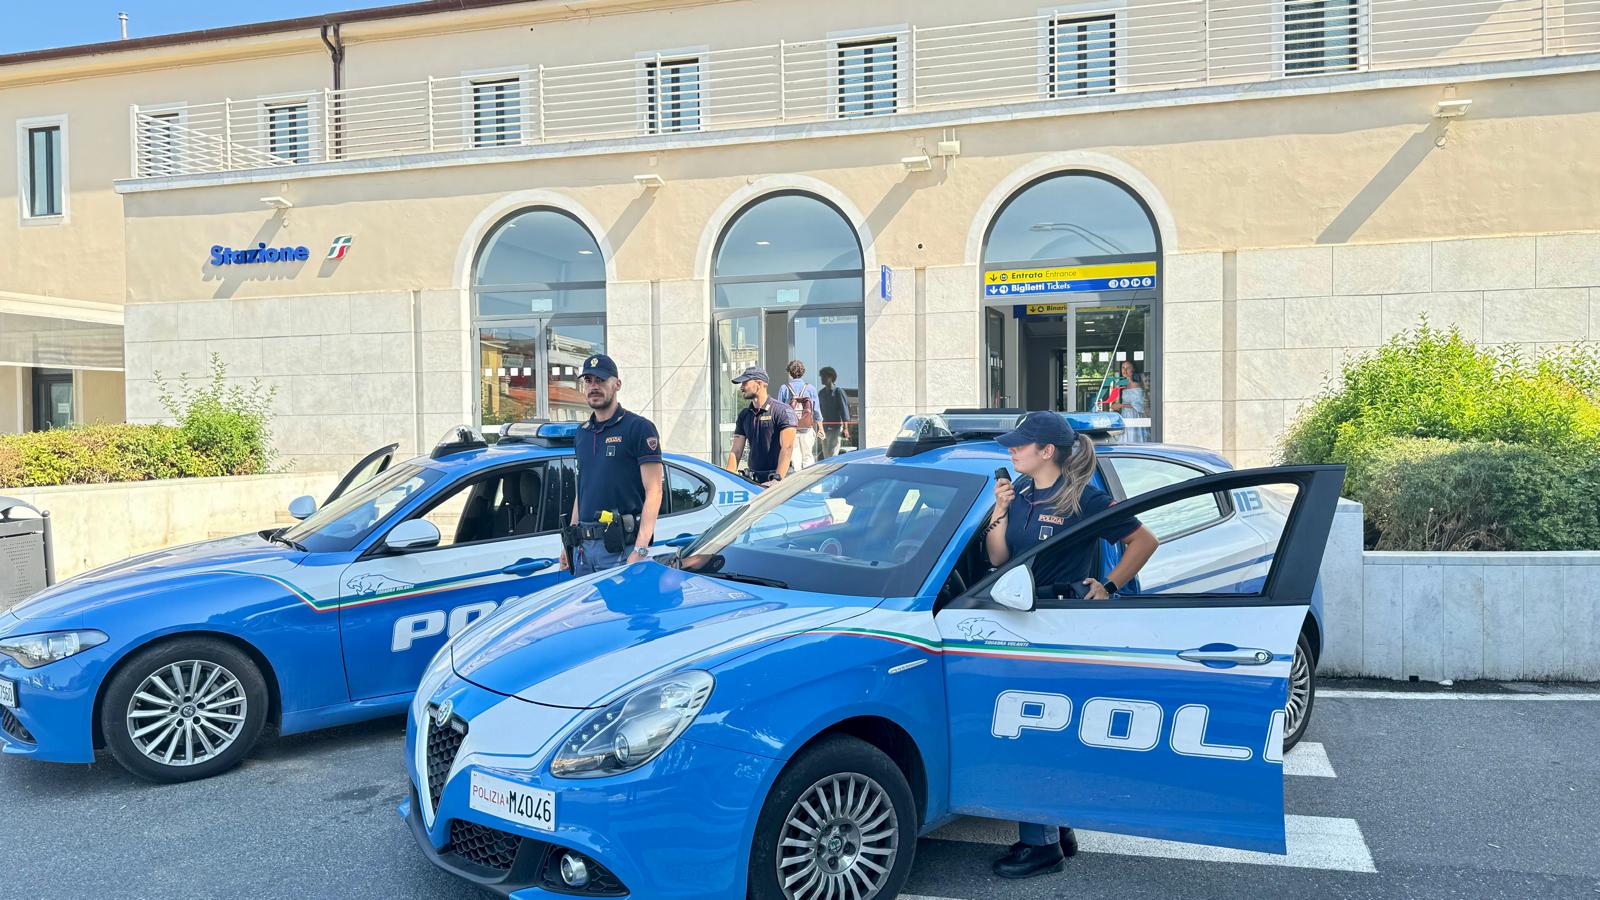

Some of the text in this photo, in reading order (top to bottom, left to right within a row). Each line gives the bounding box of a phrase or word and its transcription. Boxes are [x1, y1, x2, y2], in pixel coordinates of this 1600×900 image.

[210, 242, 309, 266] Stazione
[1011, 270, 1077, 280] Entrata Entrance
[1011, 281, 1071, 292] Biglietti Tickets
[719, 491, 749, 504] 113
[1233, 491, 1263, 512] 113
[1039, 515, 1063, 524] POLIZIA
[473, 785, 551, 822] POLIZIA M4046
